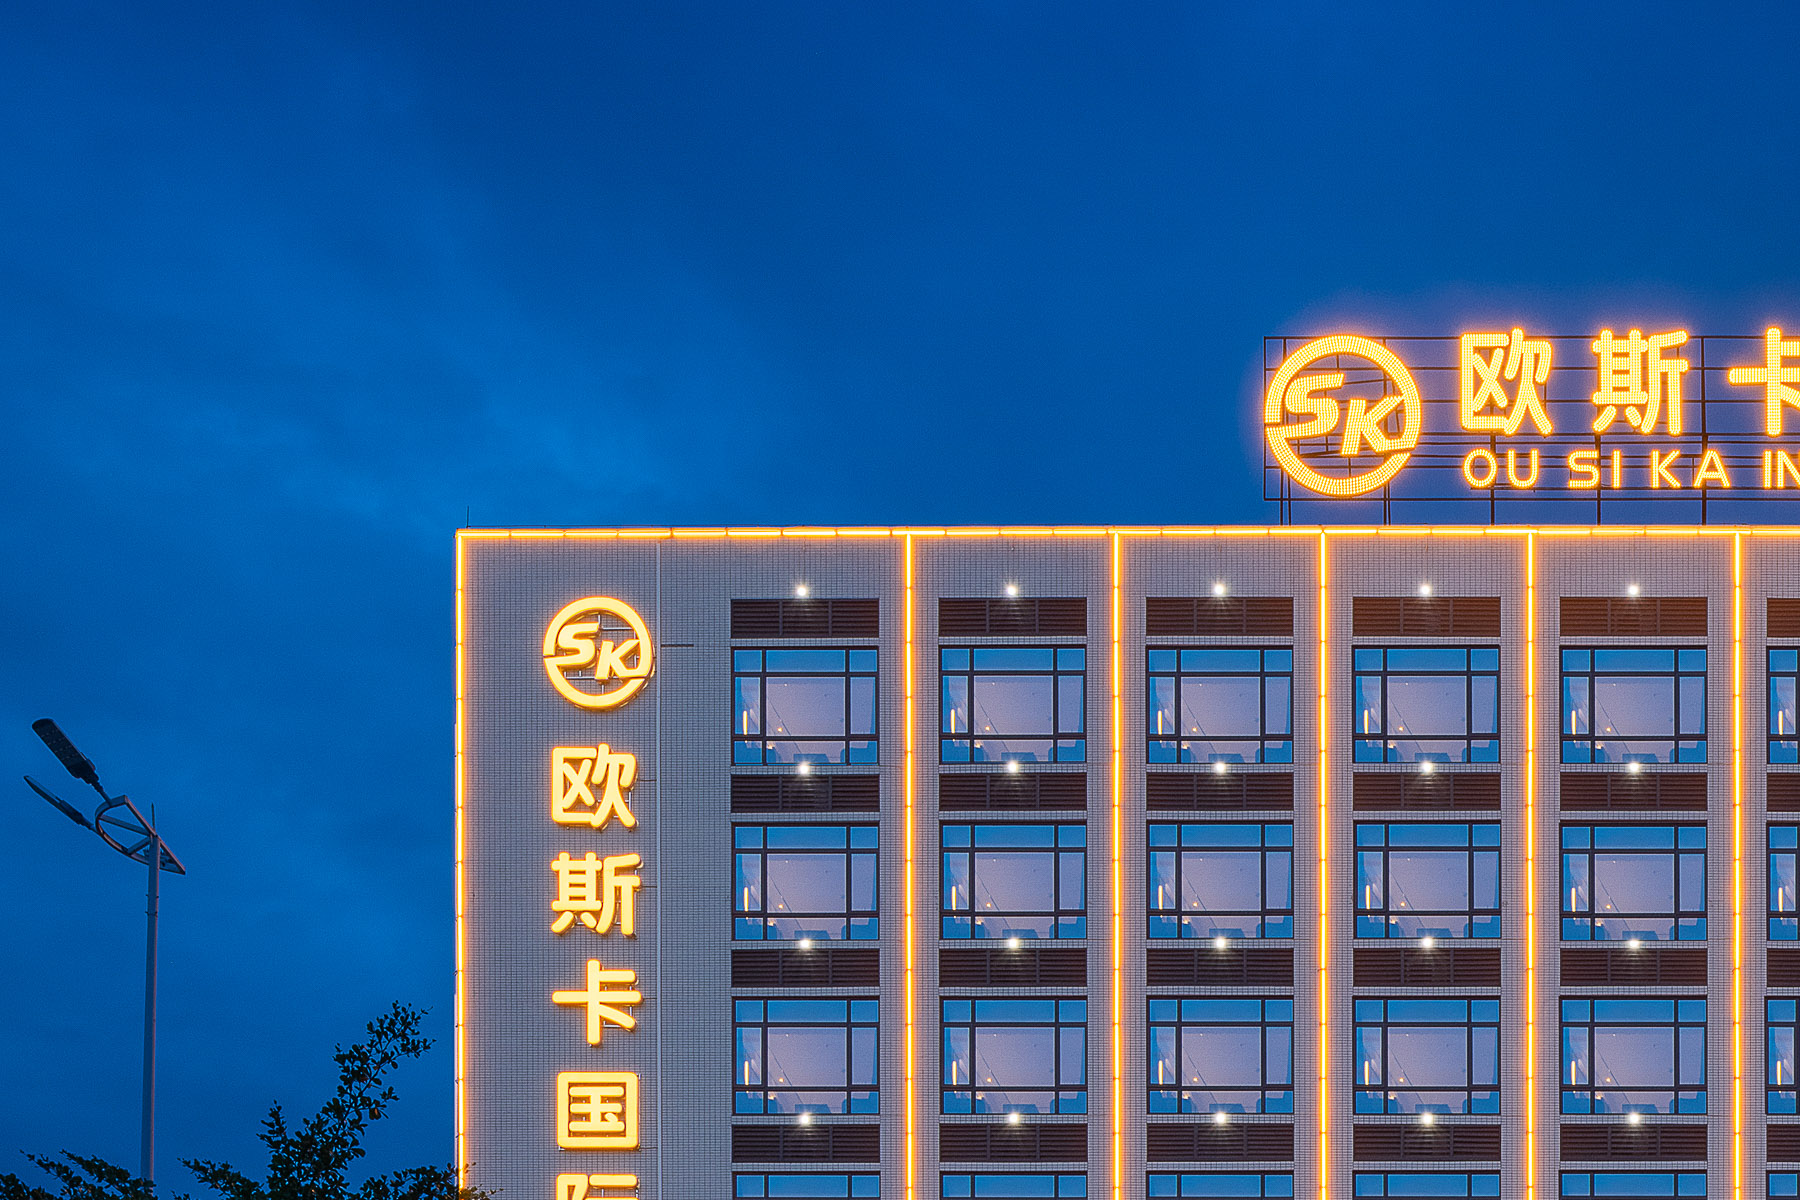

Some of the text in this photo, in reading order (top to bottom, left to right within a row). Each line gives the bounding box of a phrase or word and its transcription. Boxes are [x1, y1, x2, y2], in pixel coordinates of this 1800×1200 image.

[1460, 448, 1541, 491] OU
[1566, 448, 1623, 491] SI
[1649, 448, 1732, 491] KA
